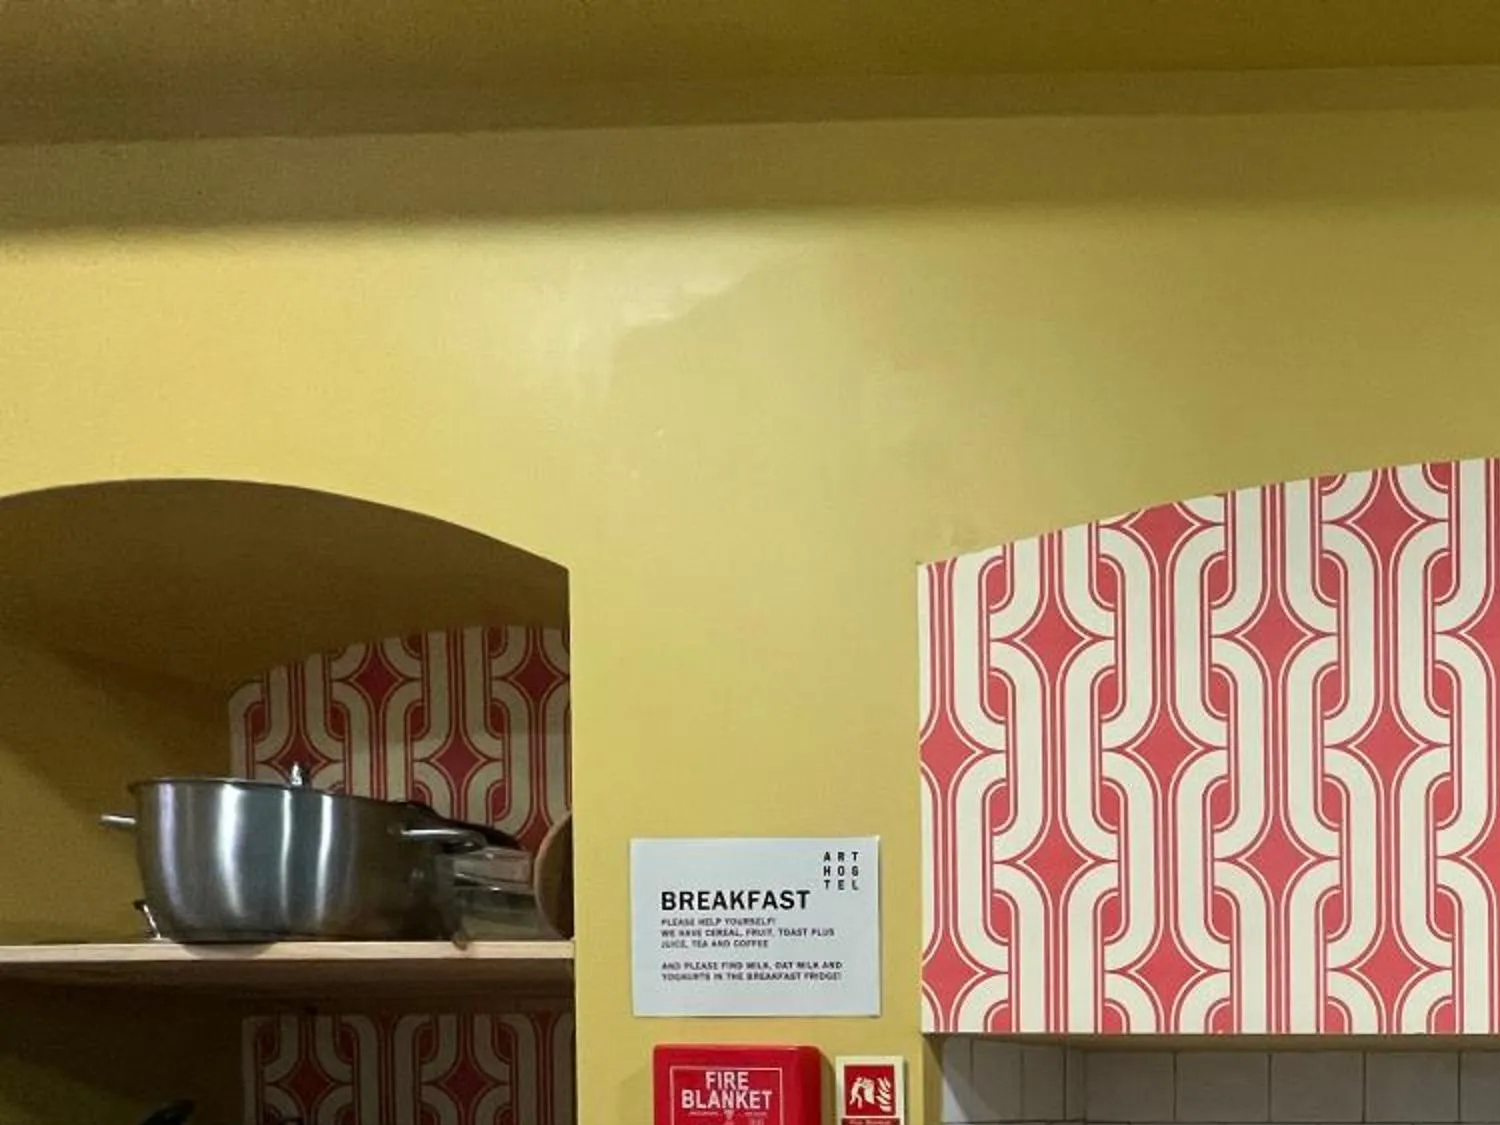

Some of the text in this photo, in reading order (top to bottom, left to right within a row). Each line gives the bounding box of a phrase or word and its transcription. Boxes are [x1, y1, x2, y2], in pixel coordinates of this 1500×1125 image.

[661, 890, 811, 911] BREAKFAST
[661, 917, 695, 927] PLEASE
[698, 917, 722, 927] HELP
[660, 928, 835, 937] WE HAVE CEREAL, FRUIT, TOAST PLUS
[661, 939, 769, 949] JUICE, TEA AND COFFEE
[661, 961, 681, 971] AND
[684, 961, 718, 971] PLEASE
[721, 961, 744, 971] FIND
[775, 961, 793, 971] OAT
[797, 961, 819, 971] MILK
[822, 961, 843, 971] AND
[661, 971, 711, 981] YOGHURTS
[713, 971, 723, 981] IN
[726, 971, 744, 981] THE
[746, 971, 801, 981] BREAKFAST
[705, 1071, 749, 1090] FIRE
[681, 1089, 773, 1110] BLANKET
